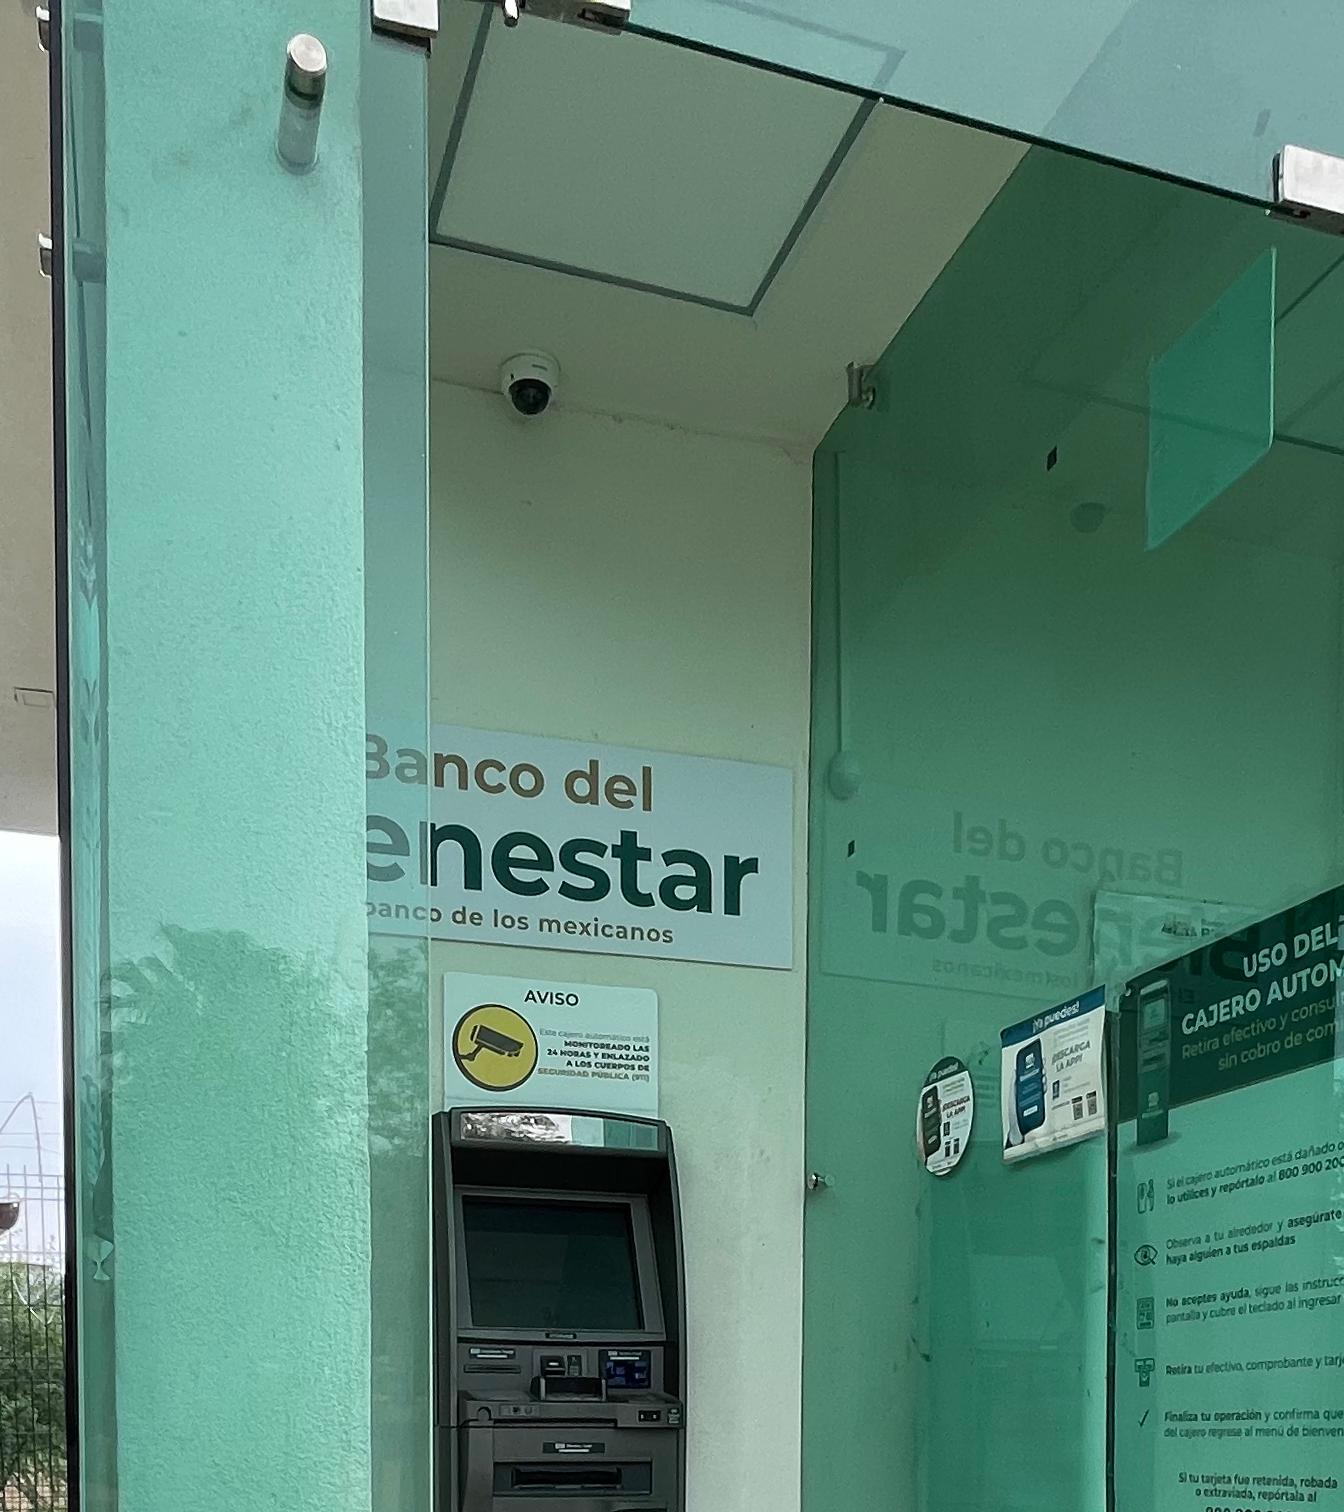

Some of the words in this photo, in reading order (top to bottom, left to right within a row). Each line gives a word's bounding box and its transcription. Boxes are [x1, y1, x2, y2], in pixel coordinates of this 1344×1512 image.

[564, 759, 652, 812] del
[366, 815, 759, 916] enestar
[451, 906, 483, 926] de
[493, 909, 529, 930] los
[539, 917, 673, 944] mexicanos
[1243, 943, 1287, 977] USO
[1294, 922, 1338, 959] DEL
[524, 990, 579, 1006] AVISO
[1181, 988, 1261, 1035] CAJERO
[564, 1041, 630, 1051] MONITOREADO
[1182, 1033, 1219, 1059] Retira
[1223, 1016, 1276, 1046] efectivo
[1280, 1014, 1288, 1031] y
[1218, 1049, 1237, 1071] sin
[1240, 1038, 1280, 1064] cobro
[1284, 1031, 1302, 1049] de
[560, 1050, 591, 1058] HORAS
[602, 1053, 649, 1061] ENLAZADO
[595, 1062, 635, 1070] CUERPOS
[1215, 1158, 1269, 1179] automático
[1295, 1141, 1335, 1161] dañado
[1338, 1140, 1344, 1151] o
[1219, 1175, 1265, 1199] repórtalo
[1278, 1166, 1299, 1181] 800
[1301, 1161, 1323, 1177] 900
[1166, 1235, 1201, 1250] Observa
[1276, 1220, 1284, 1232] y
[1287, 1209, 1342, 1229] asegúrate
[1166, 1251, 1187, 1266] haya
[1189, 1245, 1223, 1262] alguien
[1233, 1240, 1249, 1254] tus
[1251, 1232, 1296, 1252] espaldas
[1166, 1296, 1179, 1307] No
[1285, 1281, 1299, 1293] las
[1210, 1306, 1236, 1319] cubre
[1238, 1304, 1247, 1316] el
[1249, 1301, 1285, 1314] teclado
[1299, 1294, 1341, 1311] ingresar
[1166, 1363, 1192, 1375] Retira
[1194, 1364, 1204, 1374] tu
[1246, 1356, 1313, 1371] comprobante
[1315, 1357, 1322, 1369] y
[1164, 1411, 1198, 1423] Finaliza
[1200, 1411, 1211, 1422] tu
[1214, 1409, 1262, 1422] operación
[1264, 1411, 1271, 1422] y
[1273, 1408, 1320, 1421] confirma
[1323, 1409, 1344, 1422] que
[1256, 1425, 1284, 1437] menú
[1287, 1425, 1300, 1437] de
[1179, 1472, 1187, 1483] Si
[1189, 1473, 1200, 1484] tu
[1202, 1474, 1232, 1488] tarjeta
[1234, 1473, 1250, 1485] fue
[1300, 1476, 1338, 1489] robada
[1258, 1488, 1304, 1503] repórtala
[1304, 1491, 1317, 1502] al
